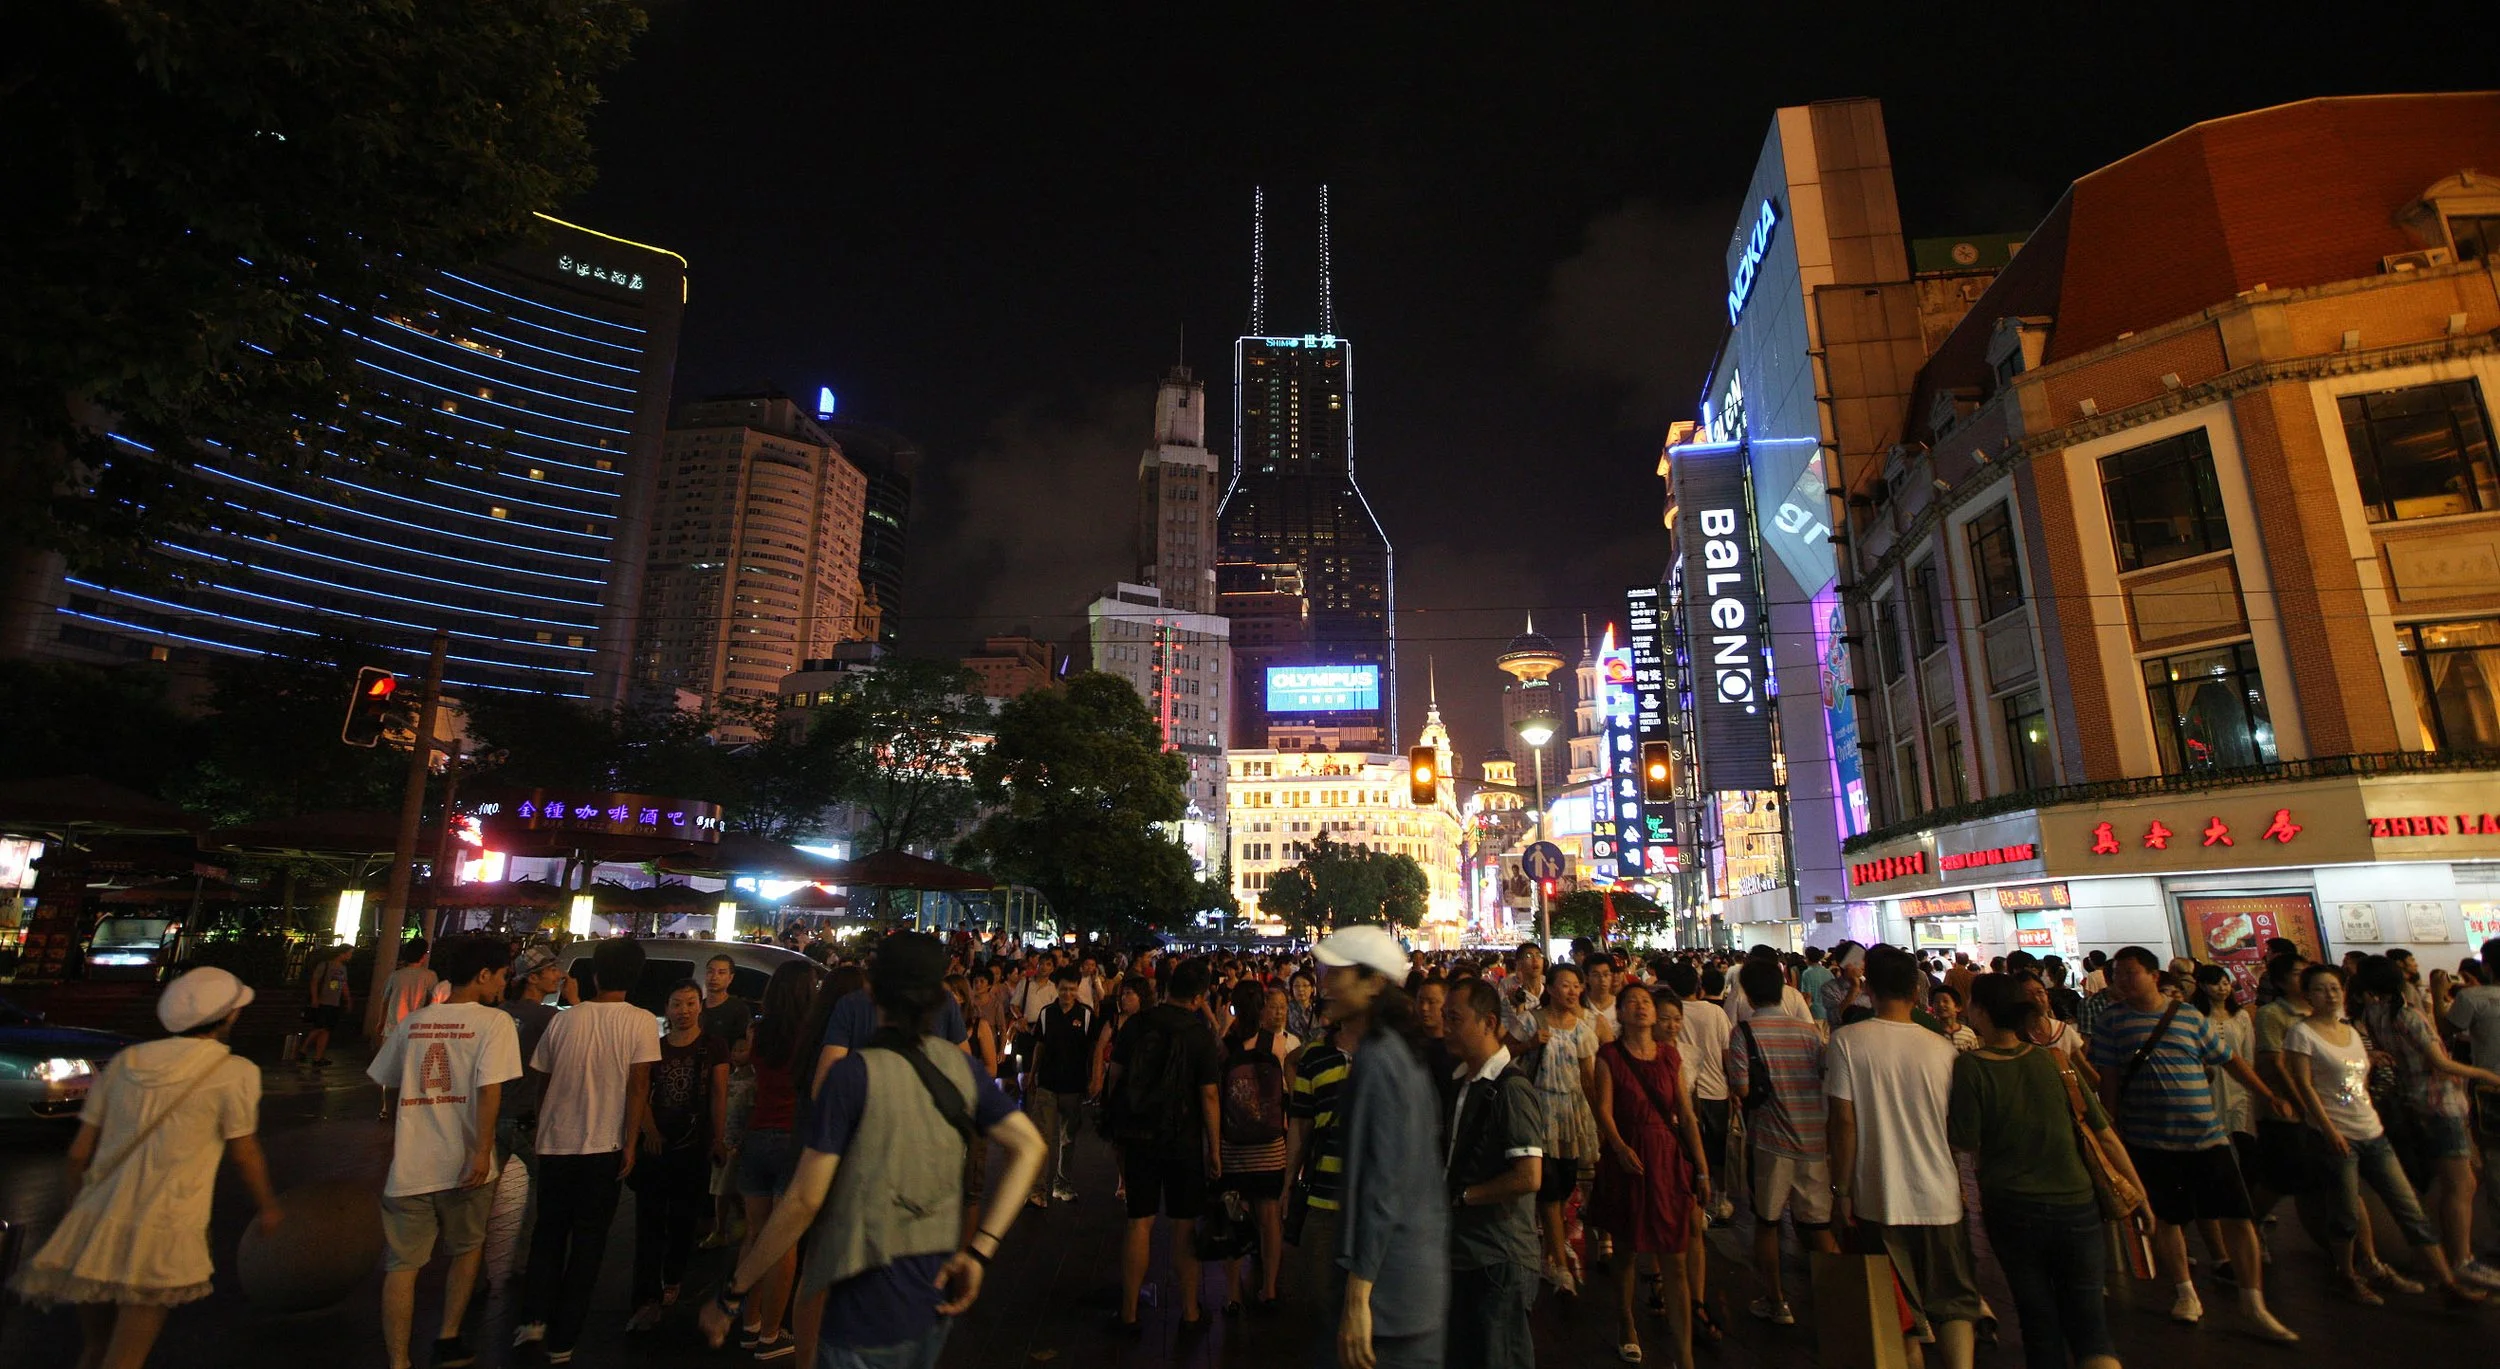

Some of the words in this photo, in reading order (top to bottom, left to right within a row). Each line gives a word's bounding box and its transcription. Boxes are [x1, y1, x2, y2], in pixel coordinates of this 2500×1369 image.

[1727, 197, 1777, 327] NOKIA
[1303, 333, 1336, 349] 世茂
[1661, 610, 1670, 621] 7
[1664, 645, 1674, 655] 6
[1271, 671, 1373, 688] OLYMPUS
[1666, 678, 1677, 690] 5
[2090, 808, 2303, 855] 真老大房
[2370, 815, 2449, 838] ZHEN
[2458, 813, 2500, 835] LA
[1679, 853, 1692, 865] B1
[1965, 850, 1987, 868] LAO
[1986, 847, 2003, 865] DA
[2002, 843, 2033, 862] FANG
